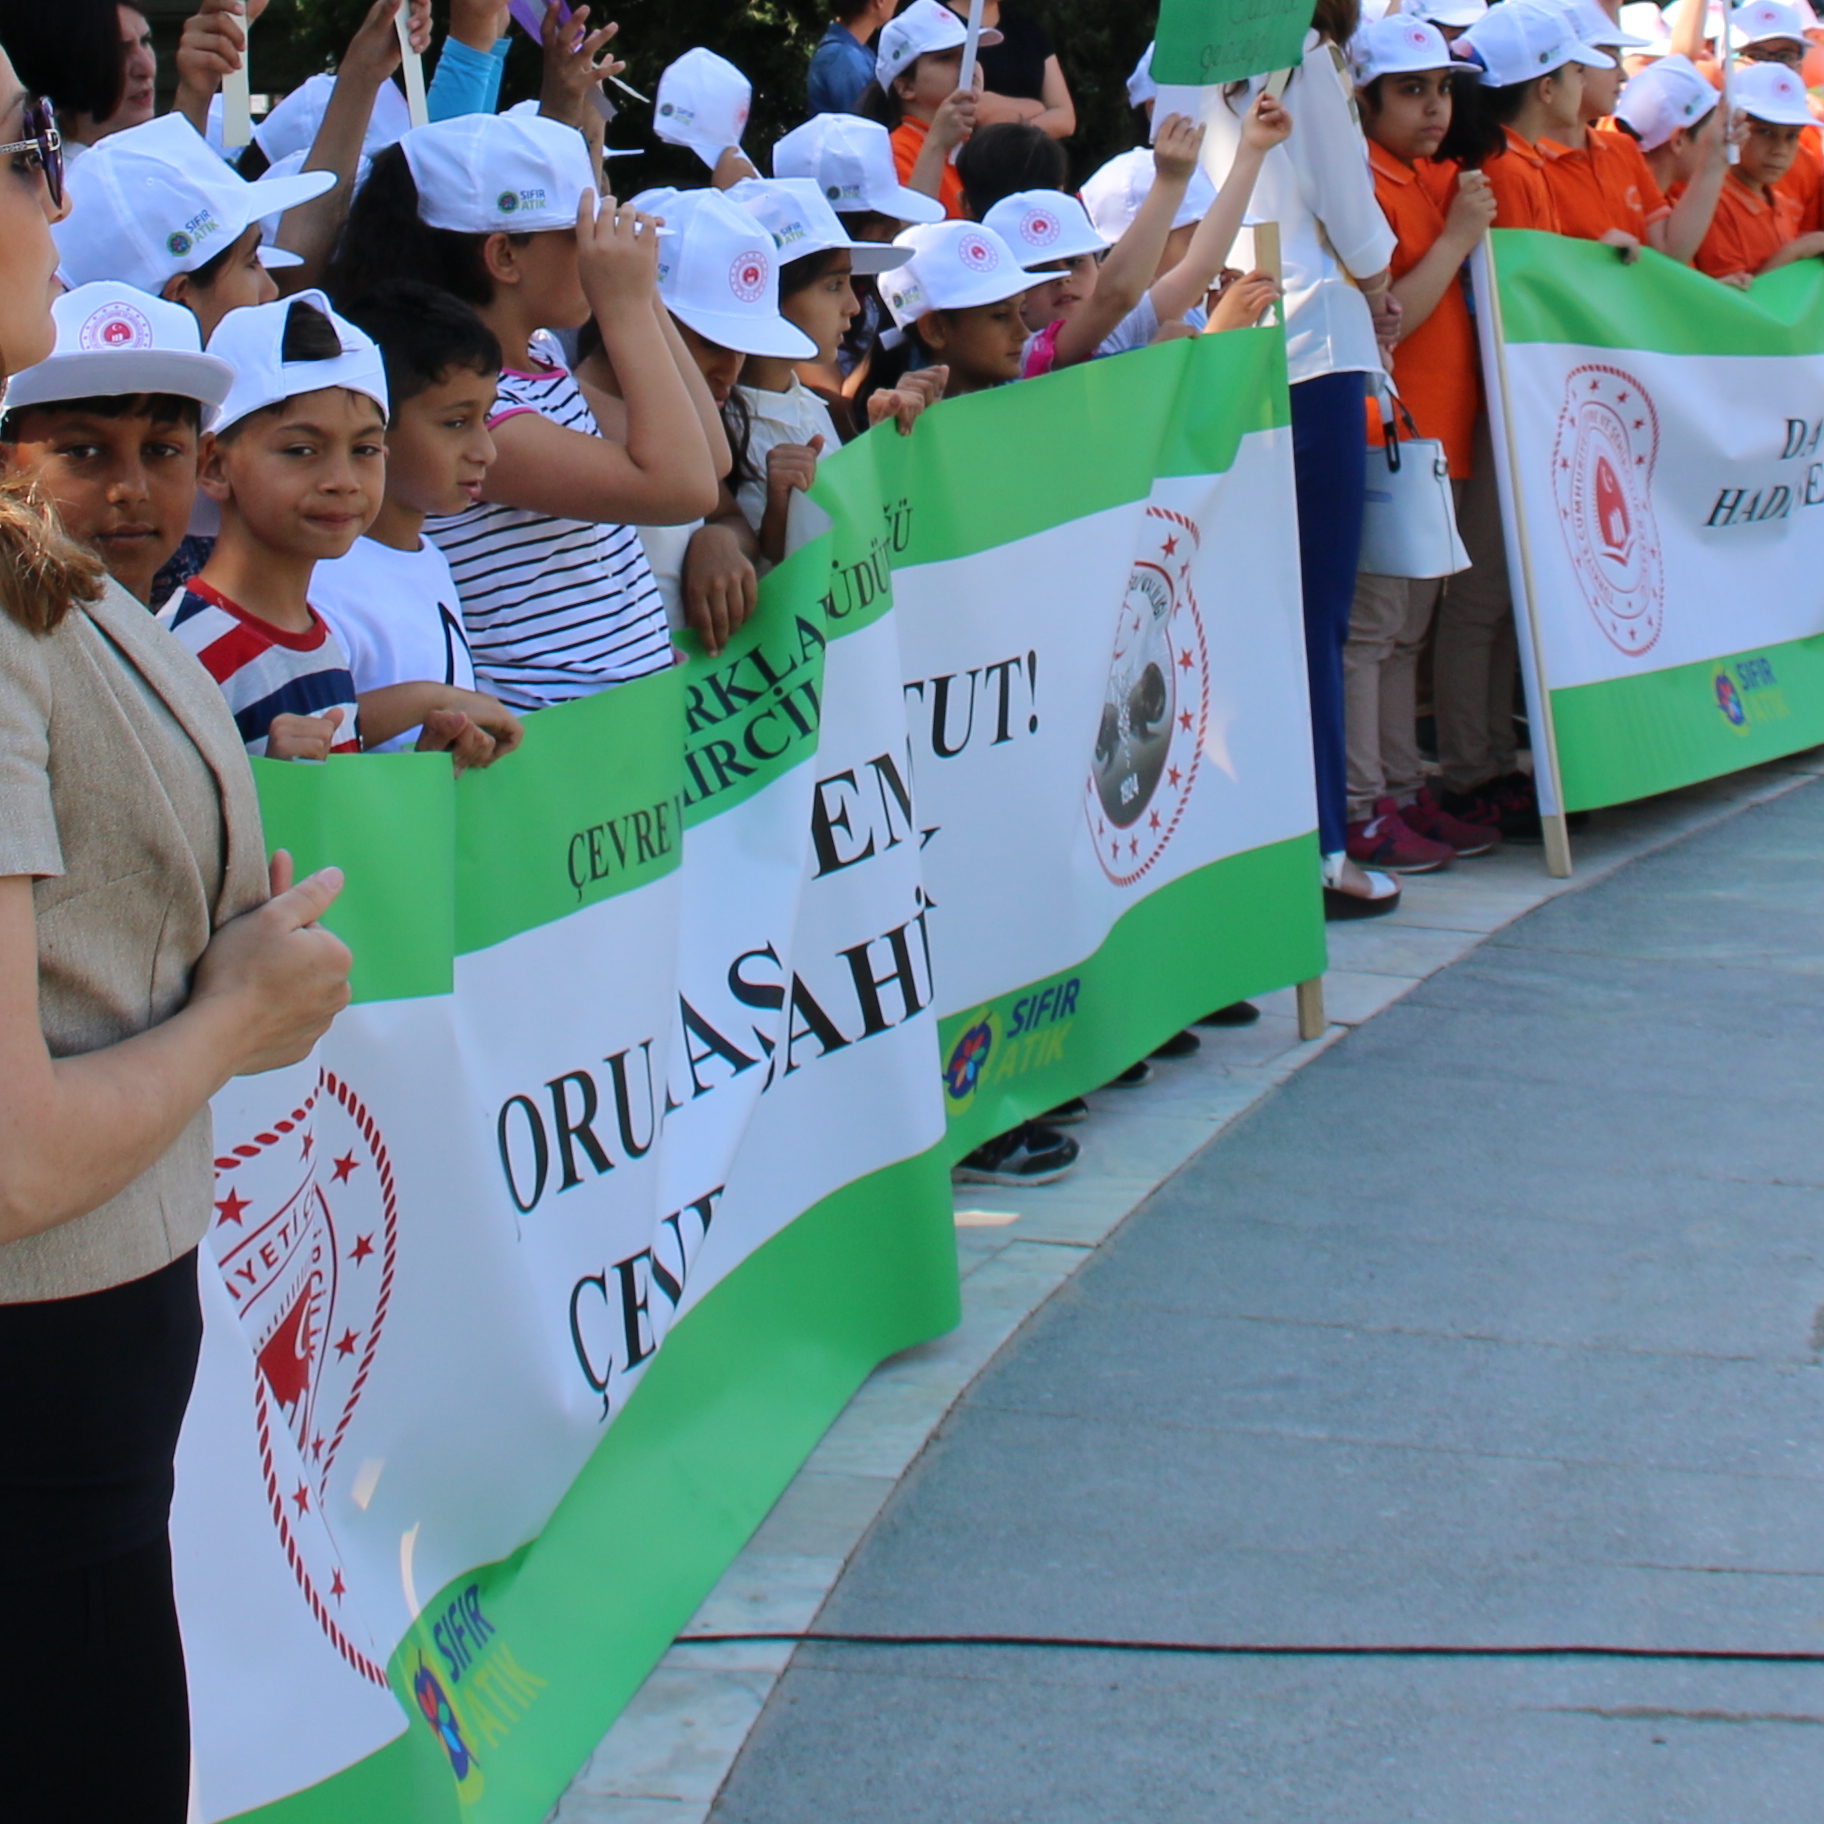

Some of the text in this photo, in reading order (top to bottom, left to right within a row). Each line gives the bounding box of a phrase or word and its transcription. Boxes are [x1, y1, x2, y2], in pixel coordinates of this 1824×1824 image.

[185, 209, 211, 234] SIFIR
[520, 189, 546, 200] SIFIR
[194, 218, 219, 243] ATIK
[567, 800, 673, 904] ÇEVRE
[1006, 978, 1081, 1039] SIFIR
[993, 1020, 1073, 1086] ATIK
[432, 1582, 496, 1685] SIFIR
[463, 1641, 549, 1750] ATIK
